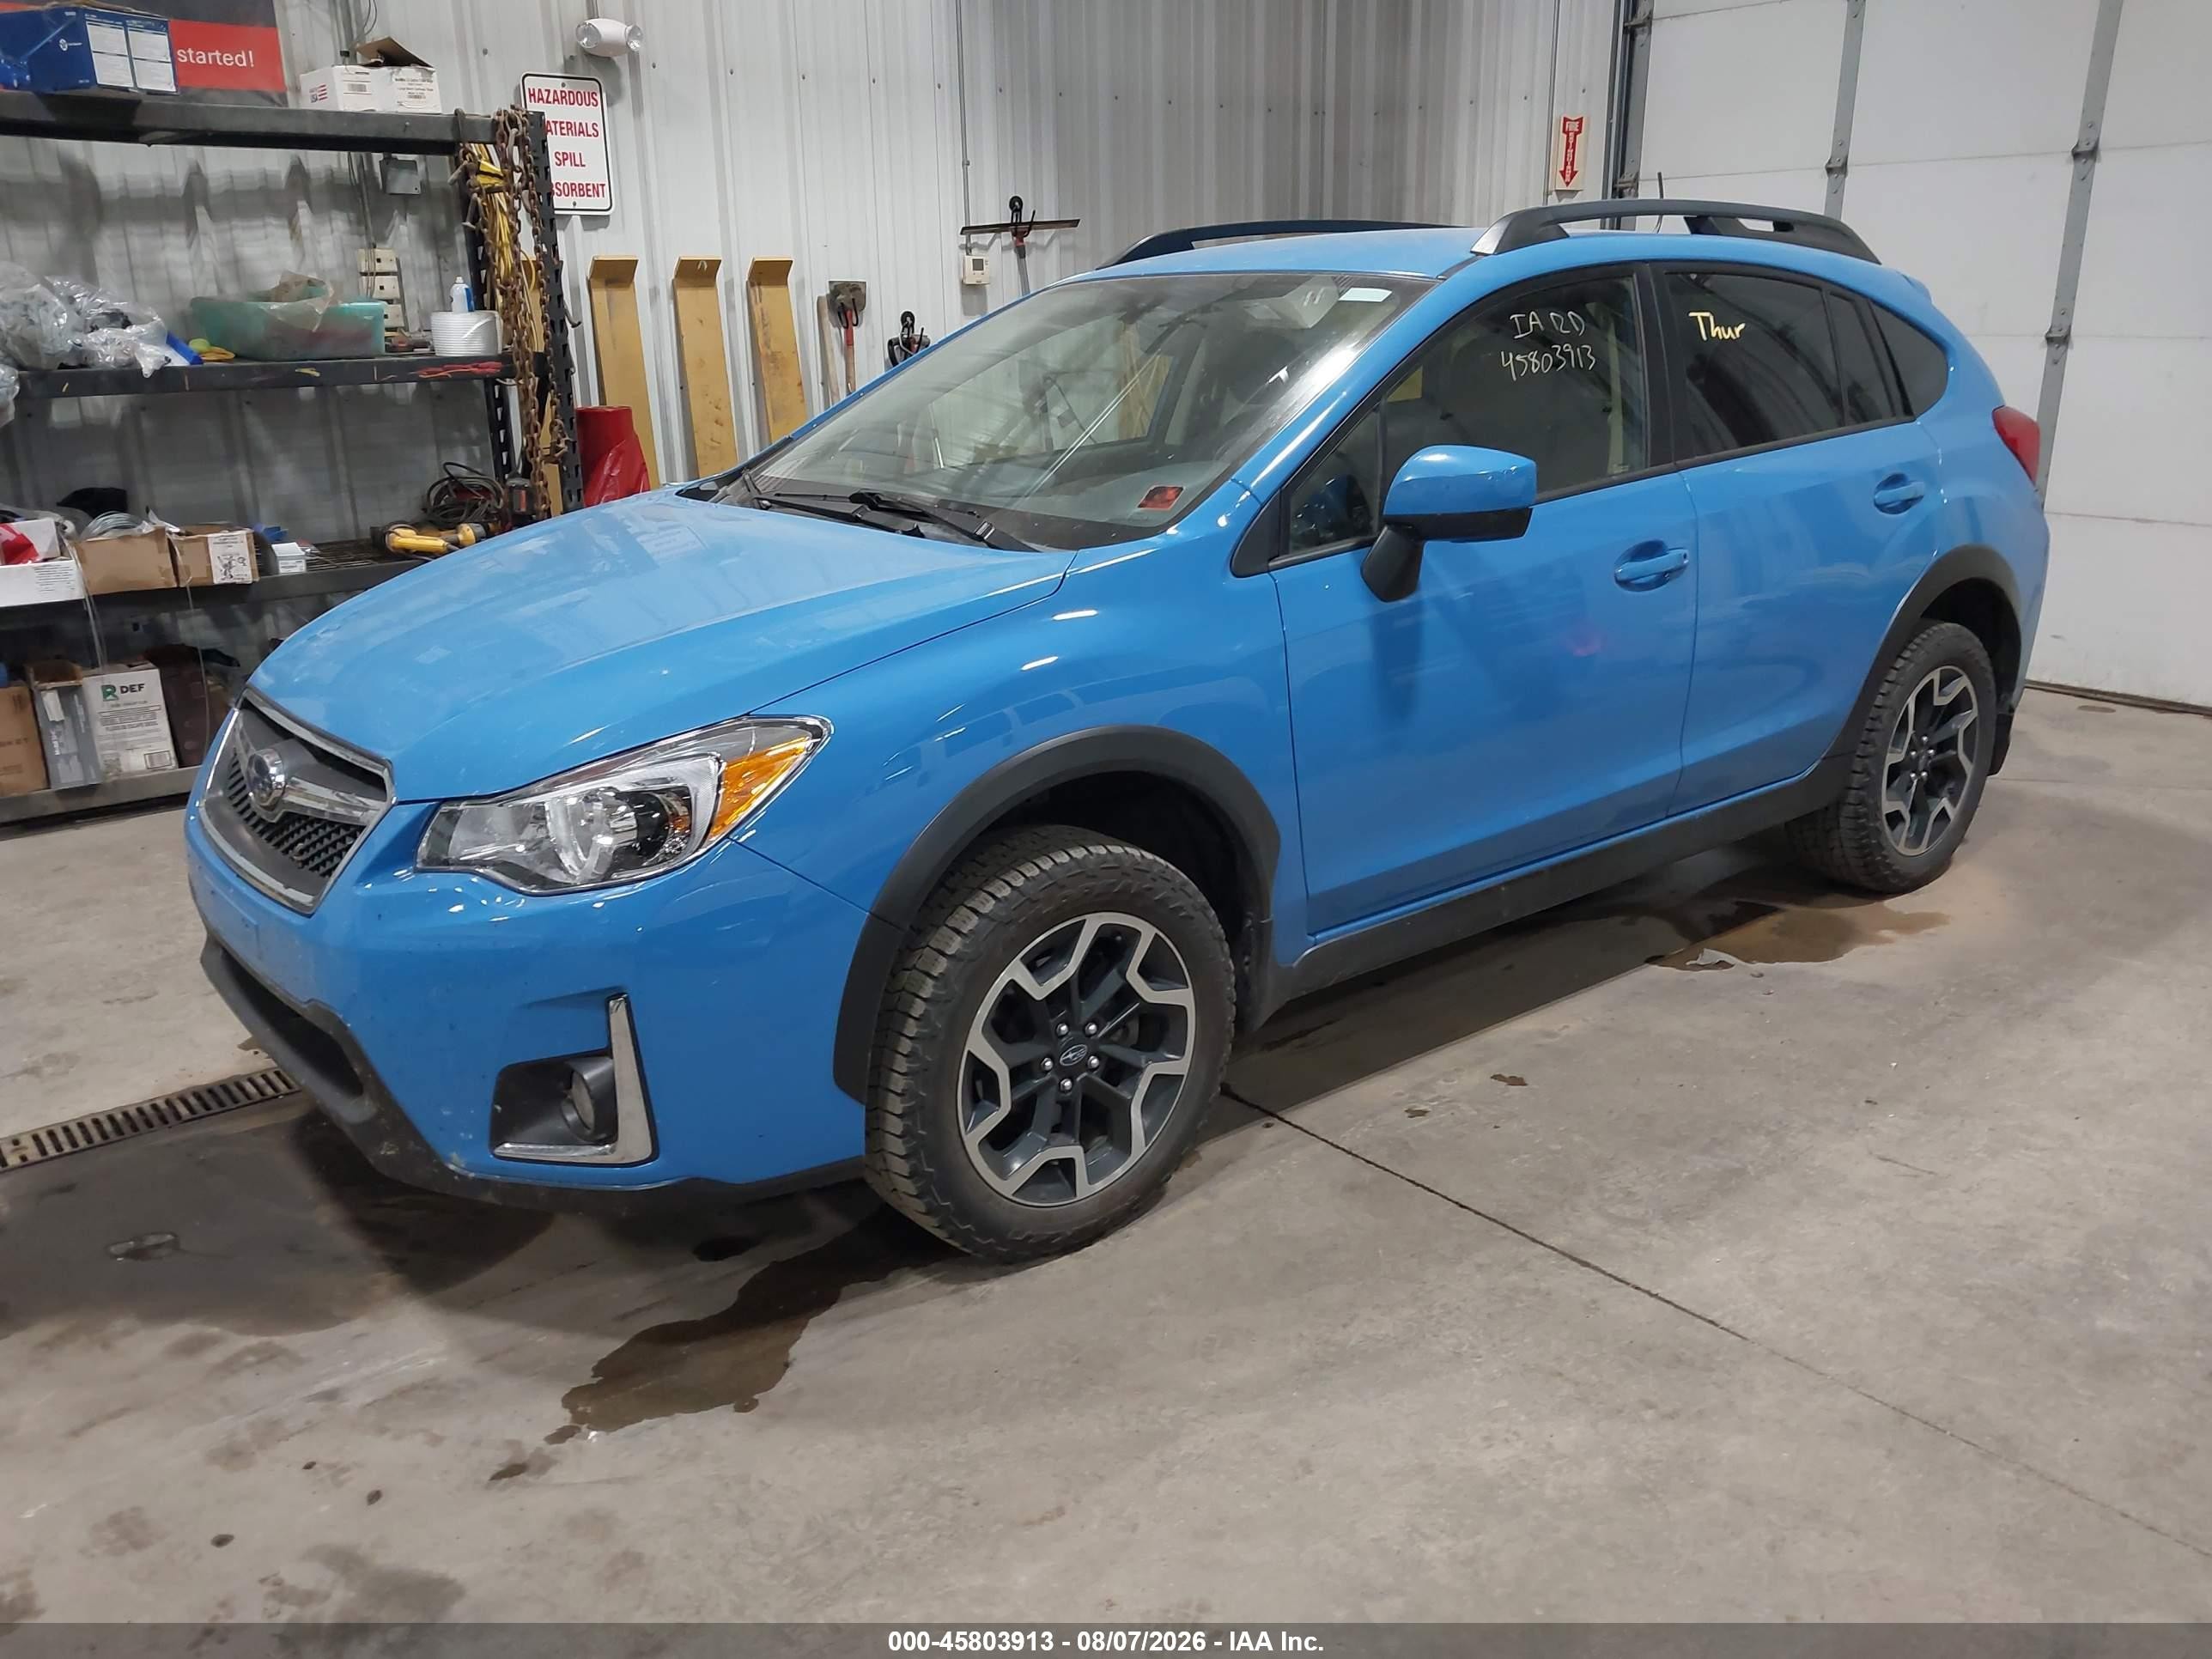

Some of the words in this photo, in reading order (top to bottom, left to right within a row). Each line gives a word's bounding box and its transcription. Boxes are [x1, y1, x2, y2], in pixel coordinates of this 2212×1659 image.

[177, 48, 254, 68] started!
[528, 88, 599, 107] HAZARDOUS
[544, 119, 599, 137] ATERIALS
[554, 151, 586, 167] SPILL
[550, 181, 606, 198] SORBENT
[1688, 312, 1746, 341] Thur
[1500, 343, 1595, 381] 45803913
[120, 684, 145, 695] DEF
